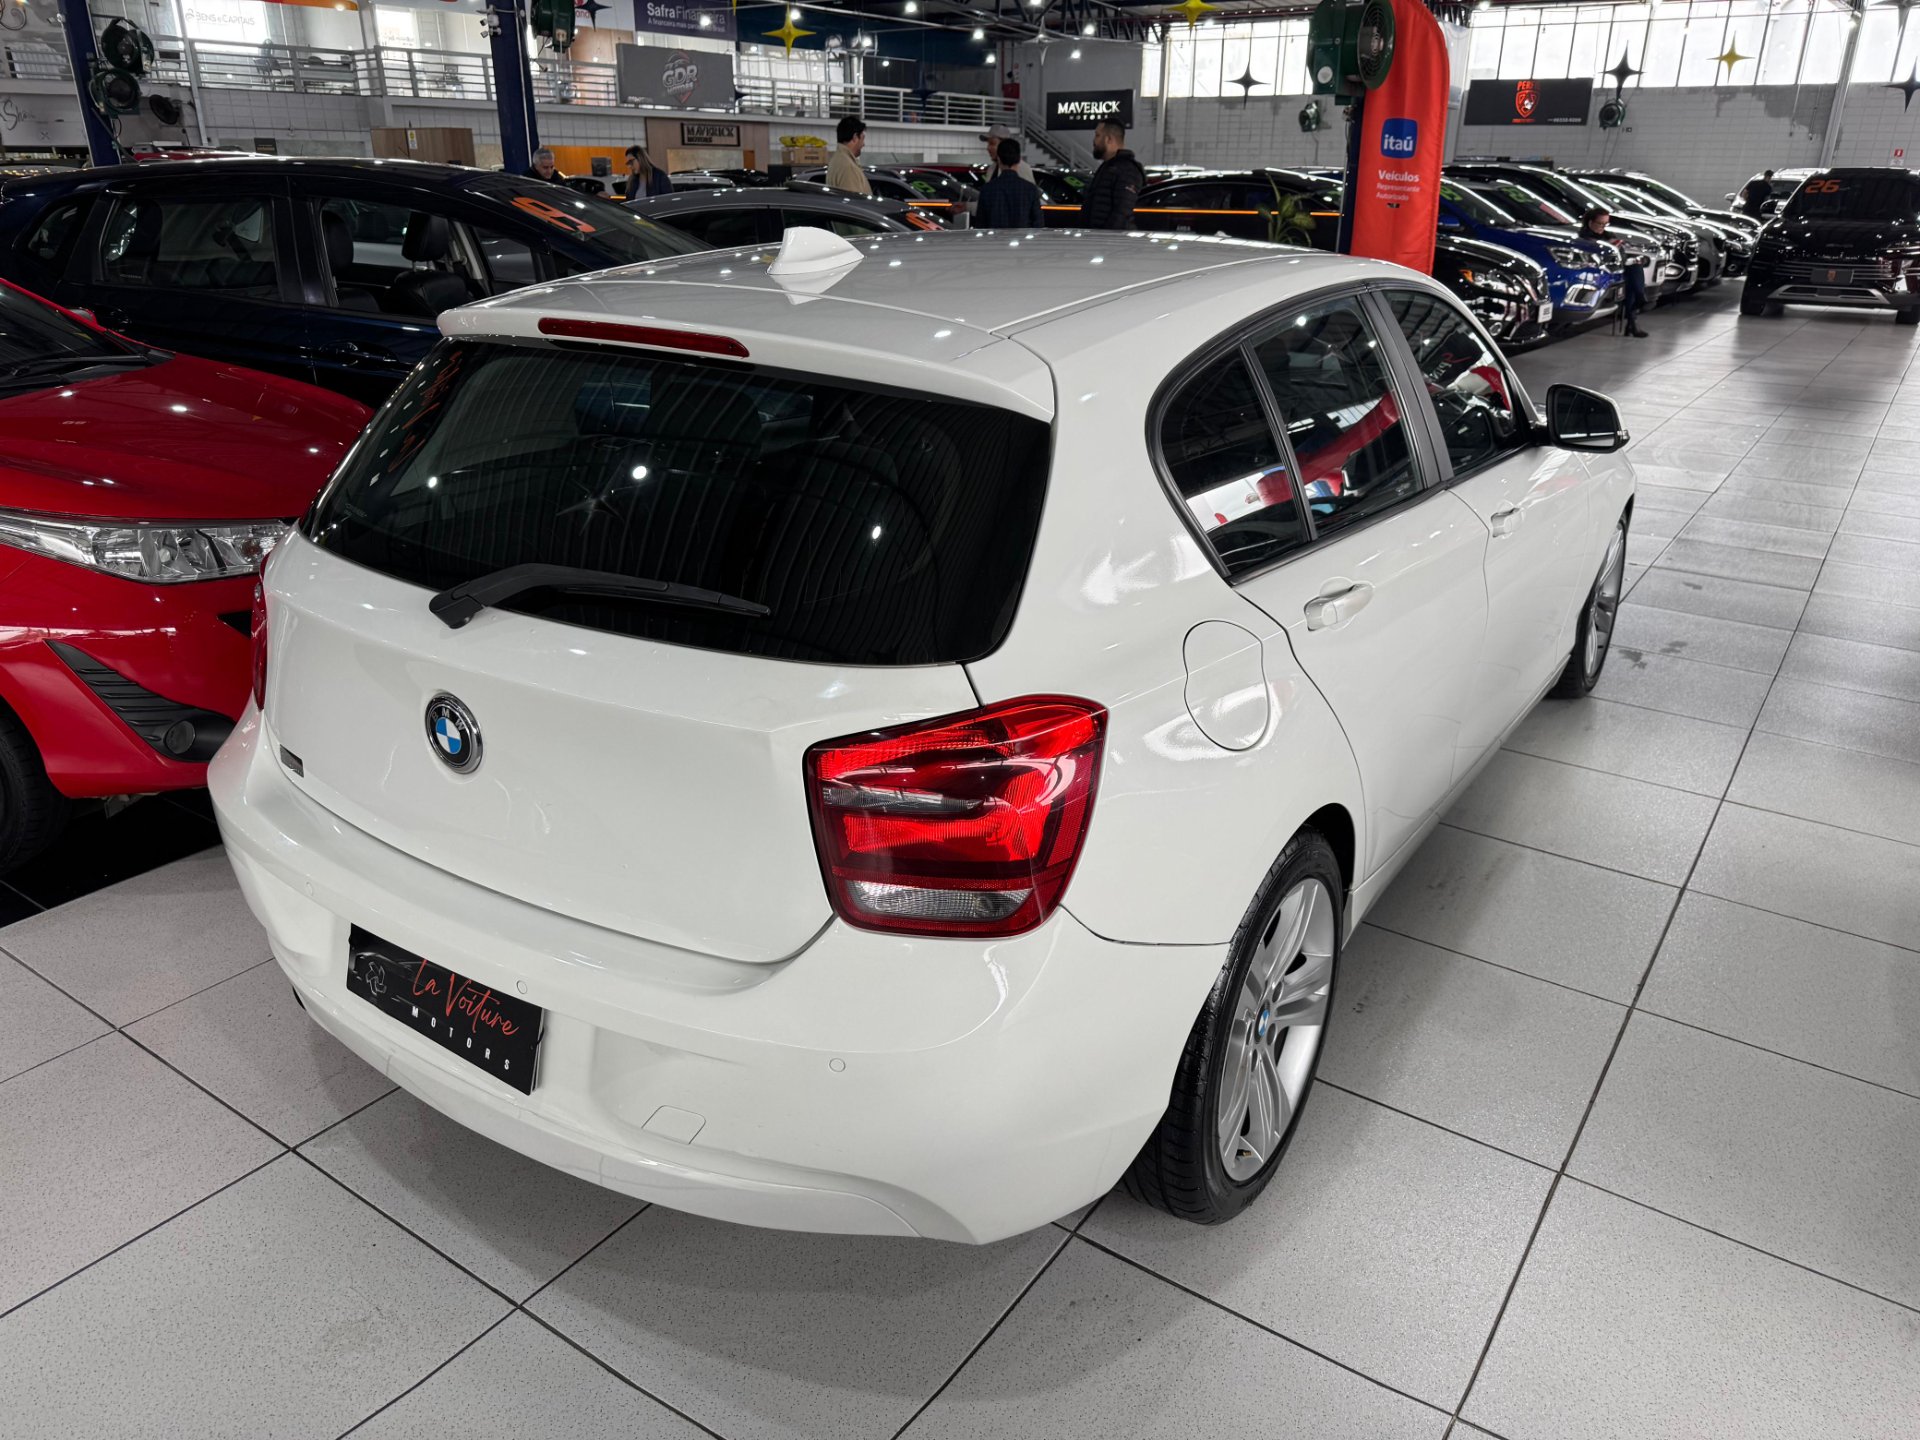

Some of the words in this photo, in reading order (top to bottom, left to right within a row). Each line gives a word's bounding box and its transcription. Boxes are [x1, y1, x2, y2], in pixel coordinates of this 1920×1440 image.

[662, 65, 698, 88] GDR
[1057, 101, 1121, 115] MAVERICK
[687, 127, 734, 137] MAVERICK
[1383, 133, 1414, 152] itaú
[1378, 169, 1420, 183] Veículos
[1804, 179, 1841, 194] 26
[431, 706, 465, 731] BMW
[412, 958, 441, 997] La
[445, 972, 520, 1036] Voiture
[411, 1005, 511, 1071] MOTORS
